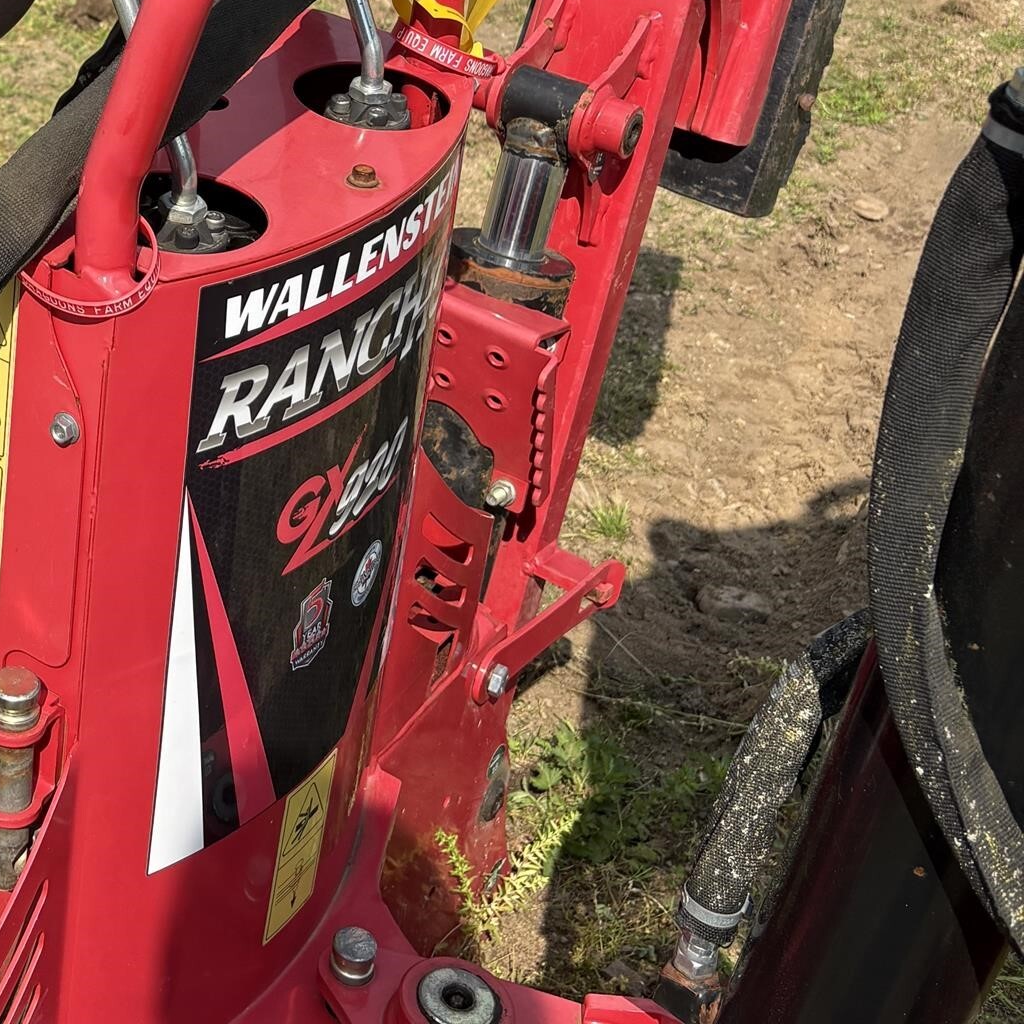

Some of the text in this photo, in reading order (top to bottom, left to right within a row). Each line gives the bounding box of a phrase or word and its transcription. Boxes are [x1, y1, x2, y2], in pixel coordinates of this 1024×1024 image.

[396, 26, 429, 55] EQUIP
[430, 44, 463, 68] FARM
[94, 298, 133, 315] FARM
